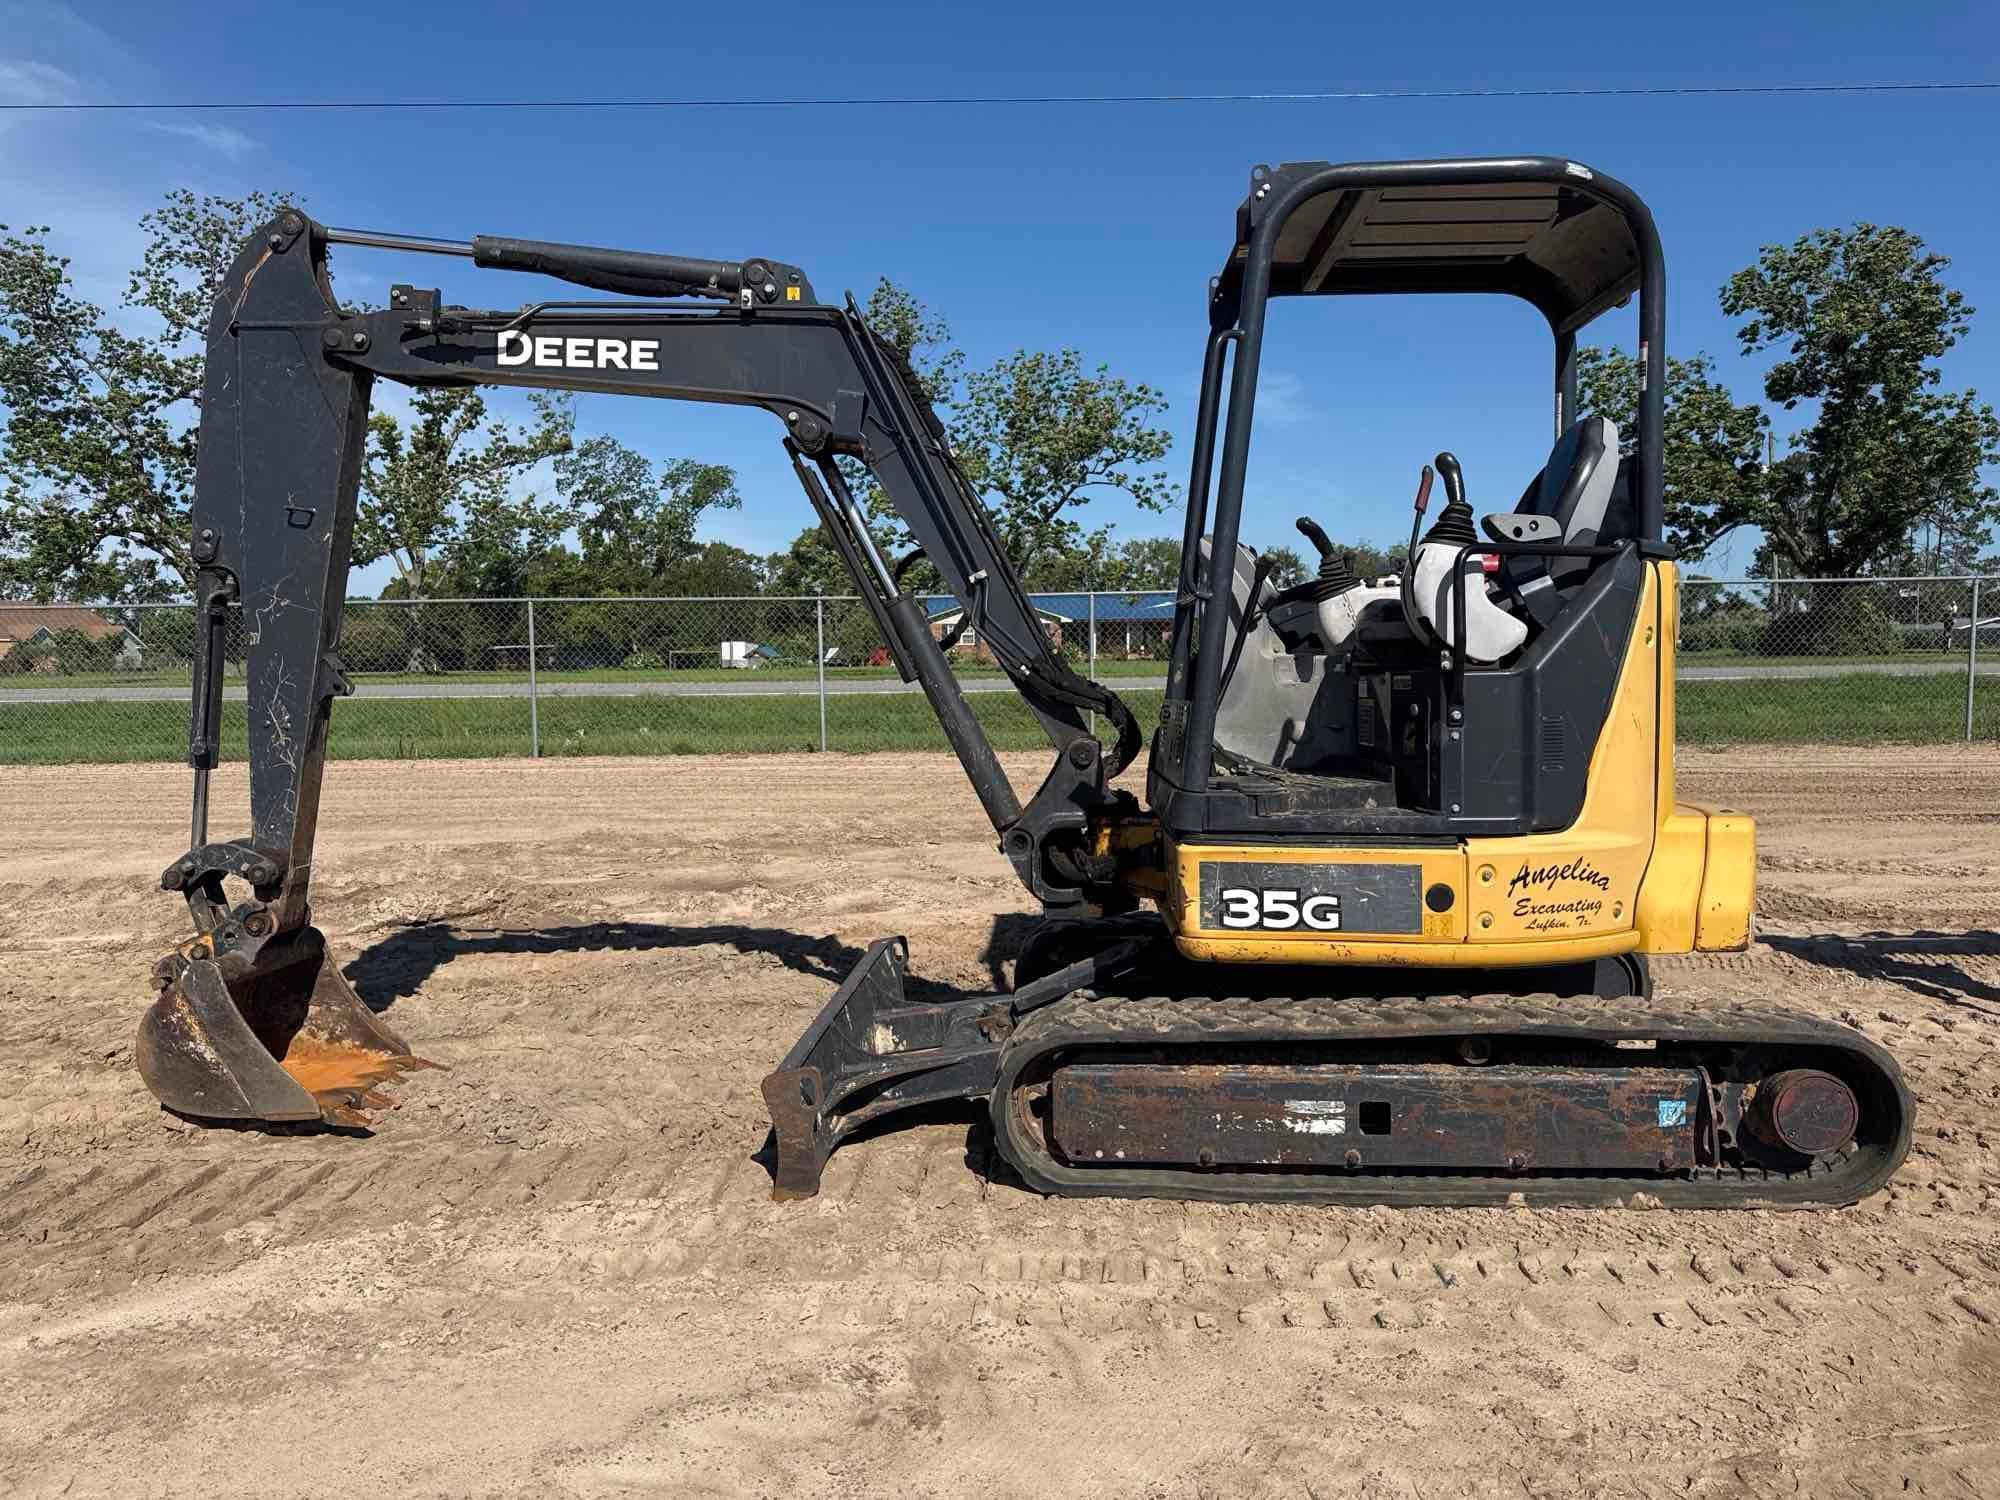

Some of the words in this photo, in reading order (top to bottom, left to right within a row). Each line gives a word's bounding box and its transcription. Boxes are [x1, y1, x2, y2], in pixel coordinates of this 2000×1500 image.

[497, 329, 660, 370] DEERE
[1507, 855, 1610, 898] Angelina
[1221, 888, 1340, 930] 35G
[1513, 898, 1602, 916] Excavating
